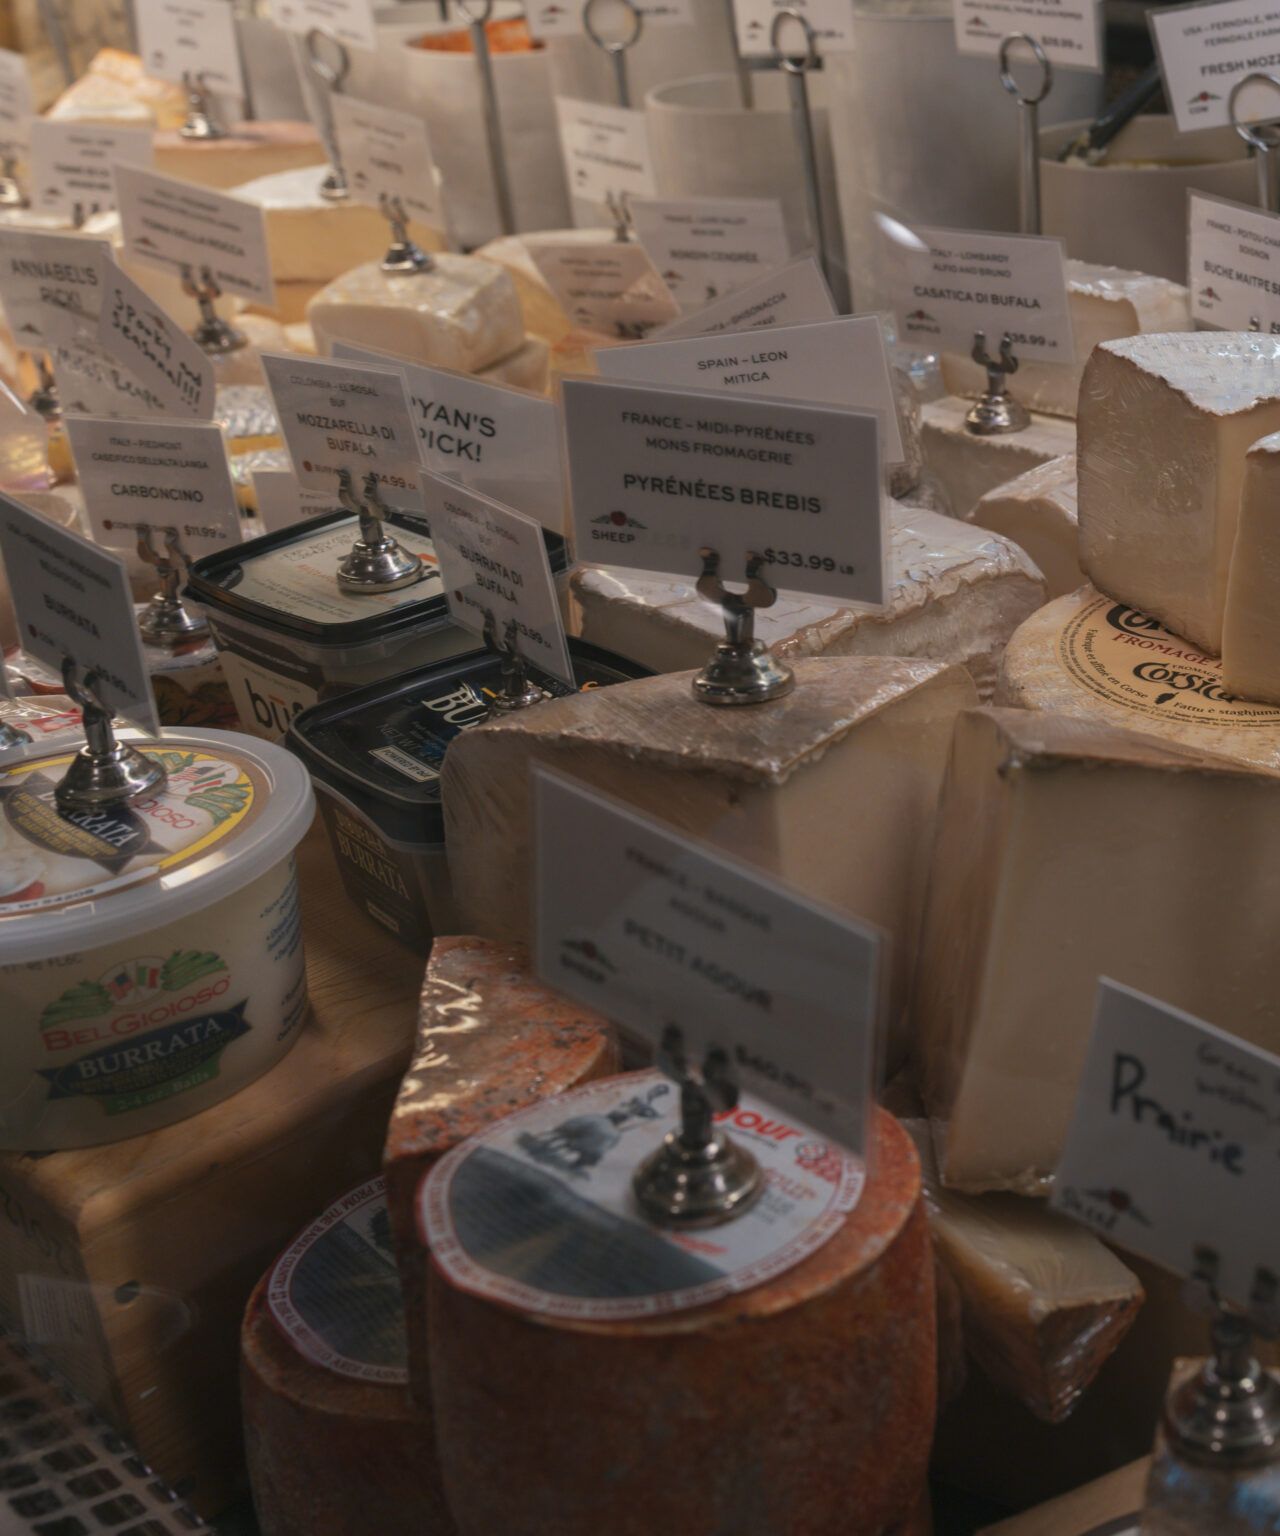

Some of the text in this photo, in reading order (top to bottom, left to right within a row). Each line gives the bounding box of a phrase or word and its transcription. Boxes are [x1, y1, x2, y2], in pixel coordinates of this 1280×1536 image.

[1182, 25, 1203, 37] USA
[1204, 31, 1255, 48] FERNDALE
[1200, 60, 1246, 78] FRESH
[1203, 260, 1235, 281] BUCHE
[1235, 271, 1271, 293] MAITRE
[912, 285, 1042, 310] CASATICA DI BUFALA
[697, 350, 789, 371] SPAIN LEON
[723, 371, 771, 386] MITICA
[296, 411, 398, 442] MOZZARELLA DI
[413, 397, 496, 437] YAN'S
[622, 410, 816, 446] FRANCE MIDI-PYRÉNÉES
[327, 437, 379, 459] BUFALA
[646, 438, 793, 465] MONS FROMAGERIE
[110, 482, 204, 503] CARBONCINO
[624, 473, 822, 514] PYRÉNÉES BREBIS
[591, 530, 636, 544] SHEEP
[459, 543, 515, 581] BURRATA
[763, 553, 855, 579] $33.99 LB
[475, 573, 519, 606] BUFALA
[1111, 633, 1209, 666] FROMAGE
[79, 1016, 224, 1079] BURRATA
[1110, 1052, 1245, 1177] Prairie
